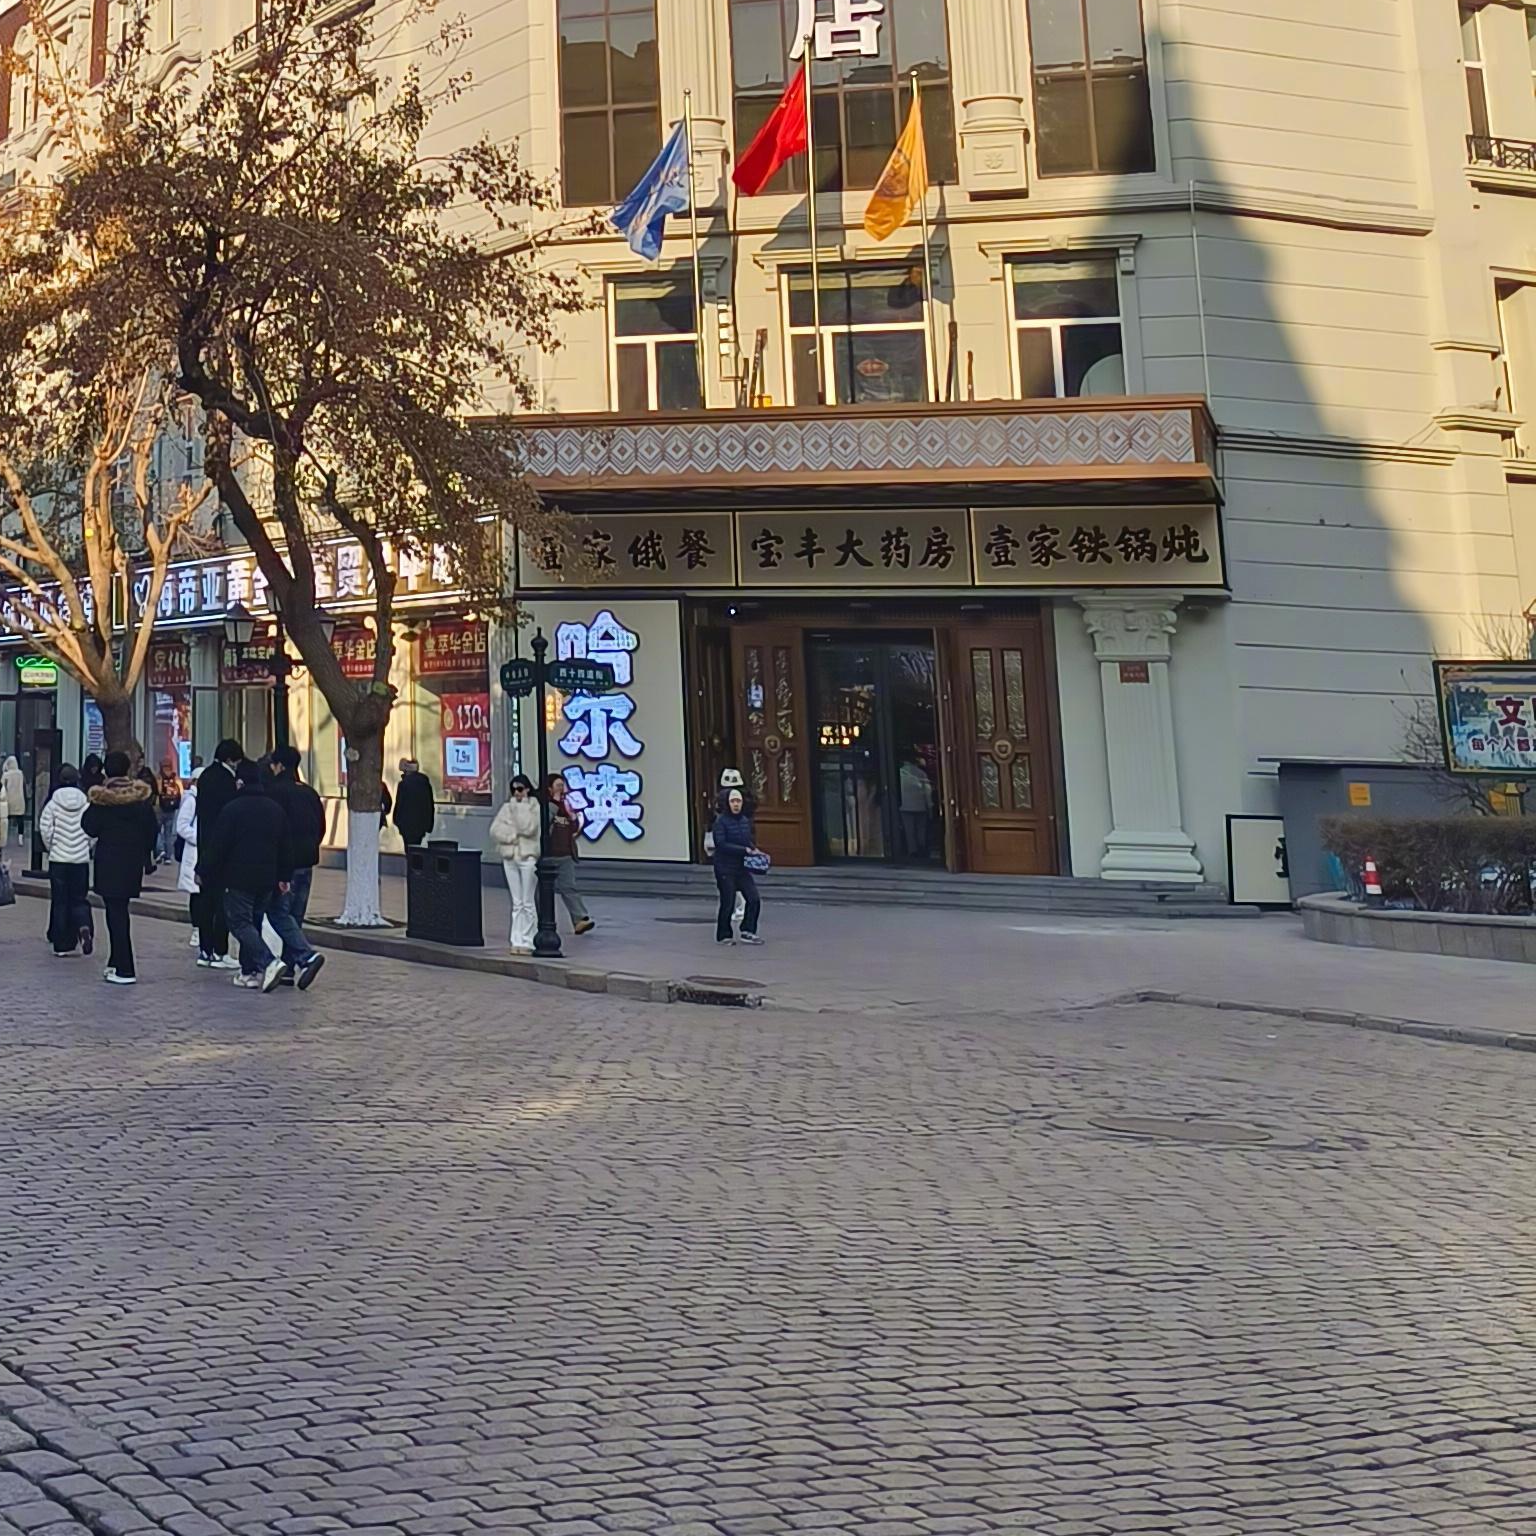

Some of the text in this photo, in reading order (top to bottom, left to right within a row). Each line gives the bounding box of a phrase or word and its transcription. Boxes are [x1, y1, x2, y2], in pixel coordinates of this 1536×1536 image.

[750, 525, 957, 570] 宝丰大药房
[983, 523, 1211, 569] 壹家铁锅炖
[556, 609, 645, 841] 哈尔滨
[1495, 696, 1536, 727] 文
